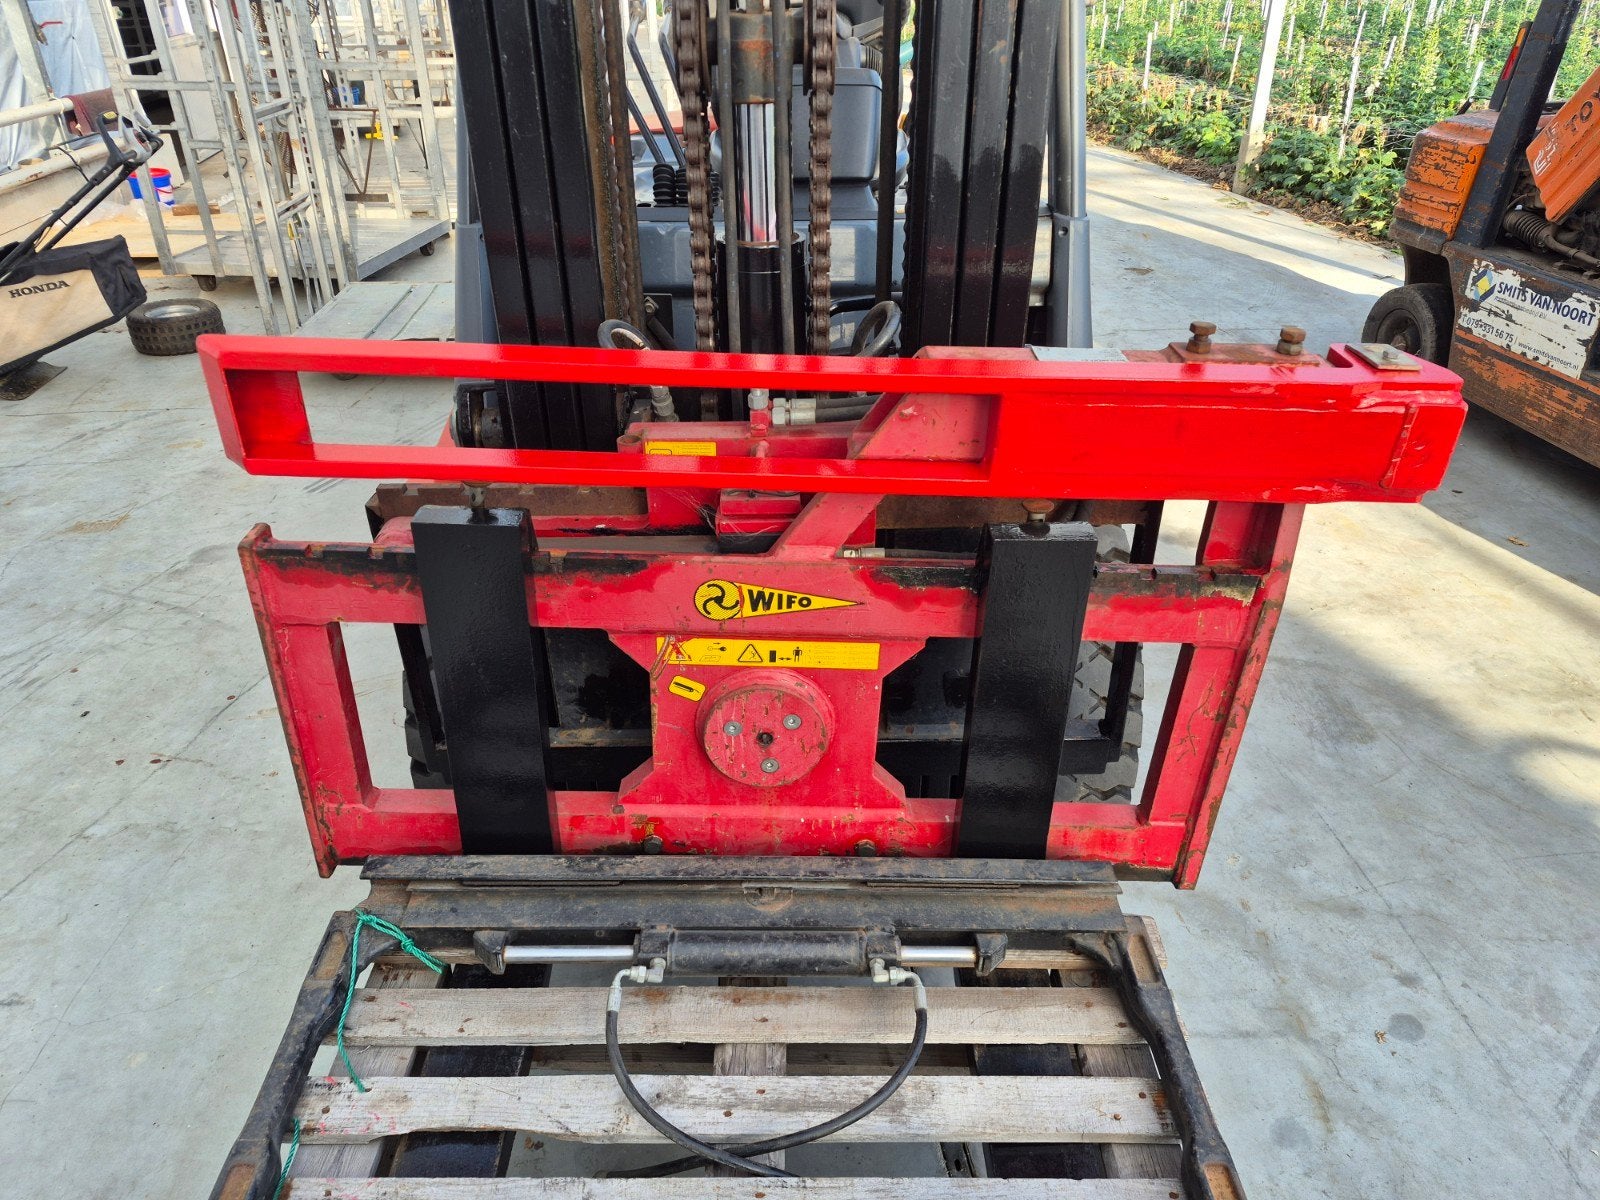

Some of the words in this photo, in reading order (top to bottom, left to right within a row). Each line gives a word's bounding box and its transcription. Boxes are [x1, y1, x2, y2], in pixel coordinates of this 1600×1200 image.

[8, 280, 70, 298] HONDA
[1497, 282, 1529, 303] SMITS
[1530, 292, 1550, 312] VAN
[1552, 301, 1597, 327] NOORT
[1495, 328, 1505, 339] 56
[1505, 332, 1515, 343] 75
[747, 588, 812, 612] WIFO
